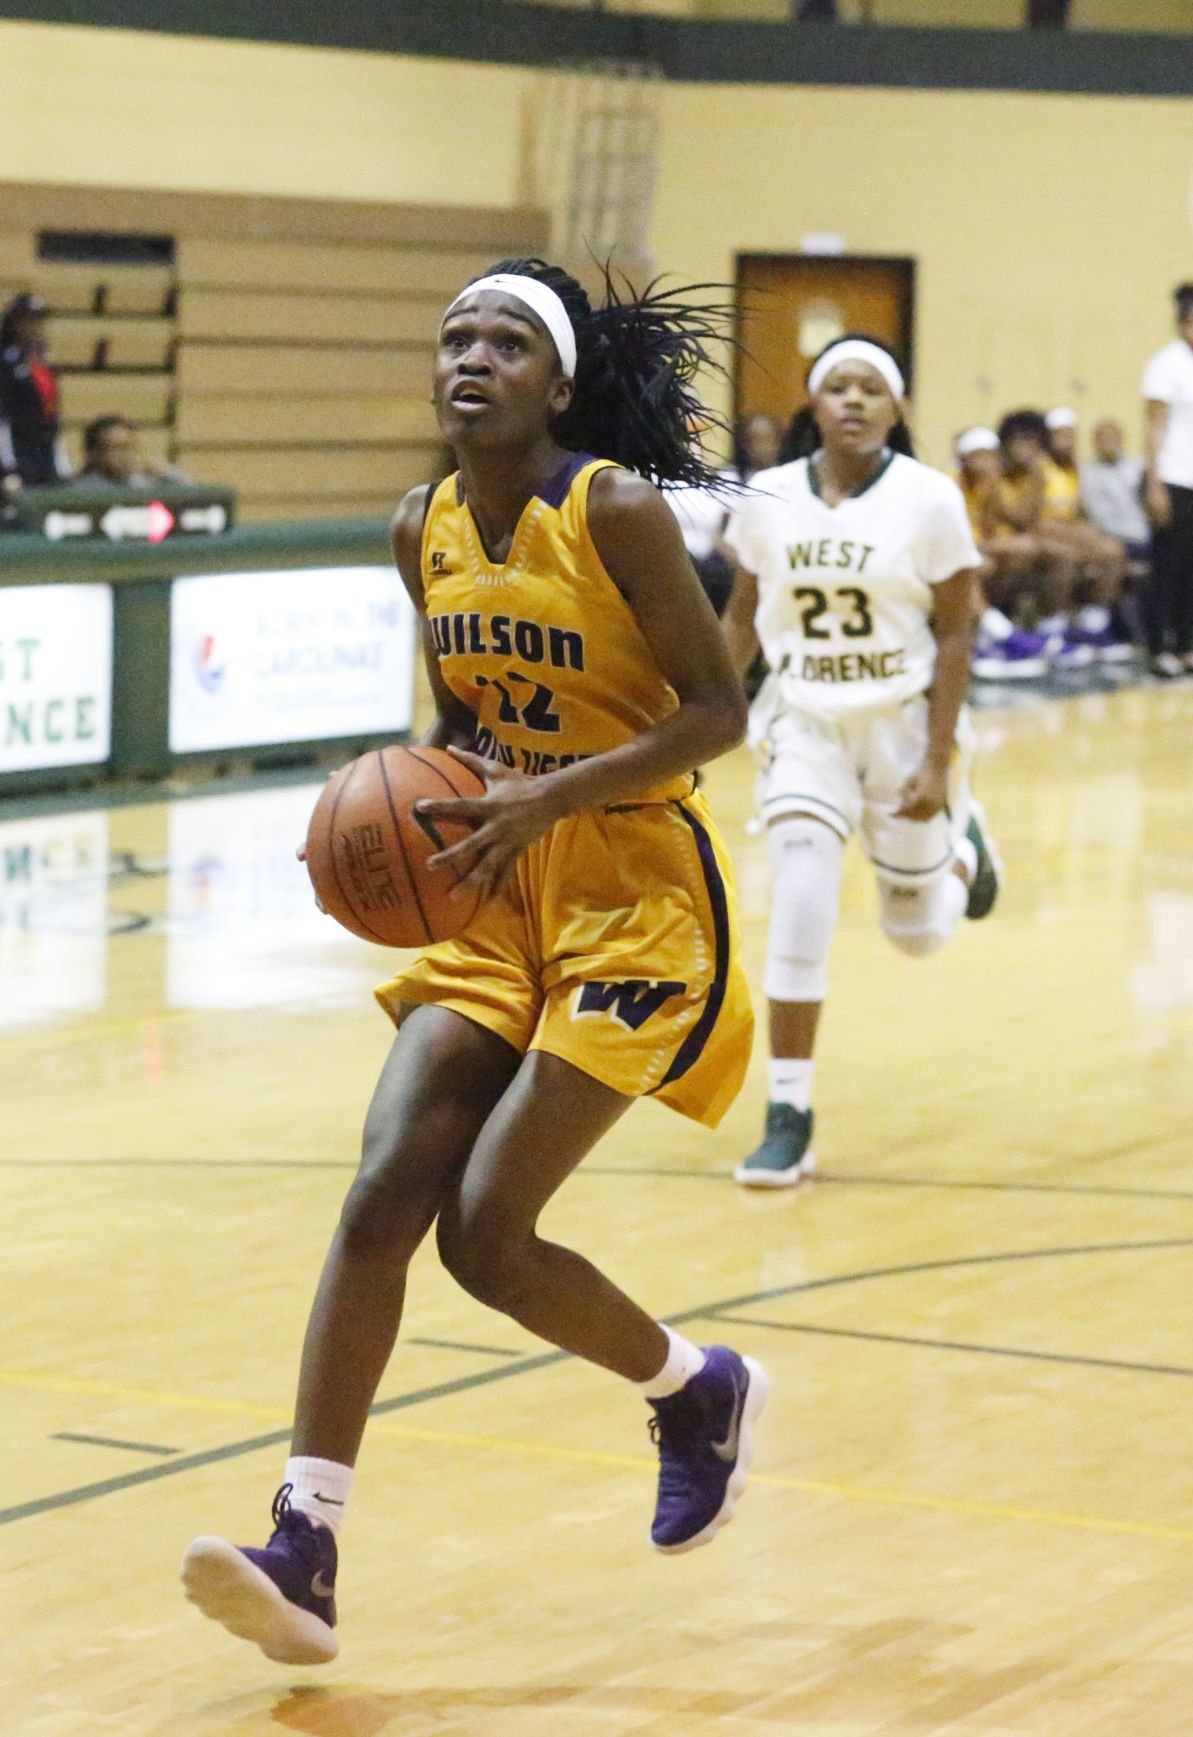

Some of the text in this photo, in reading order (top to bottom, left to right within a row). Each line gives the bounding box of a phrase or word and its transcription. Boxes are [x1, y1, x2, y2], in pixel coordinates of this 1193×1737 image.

[786, 540, 875, 572] WEST
[792, 585, 874, 640] 23
[0, 637, 40, 683] T
[779, 648, 907, 684] ORENCE
